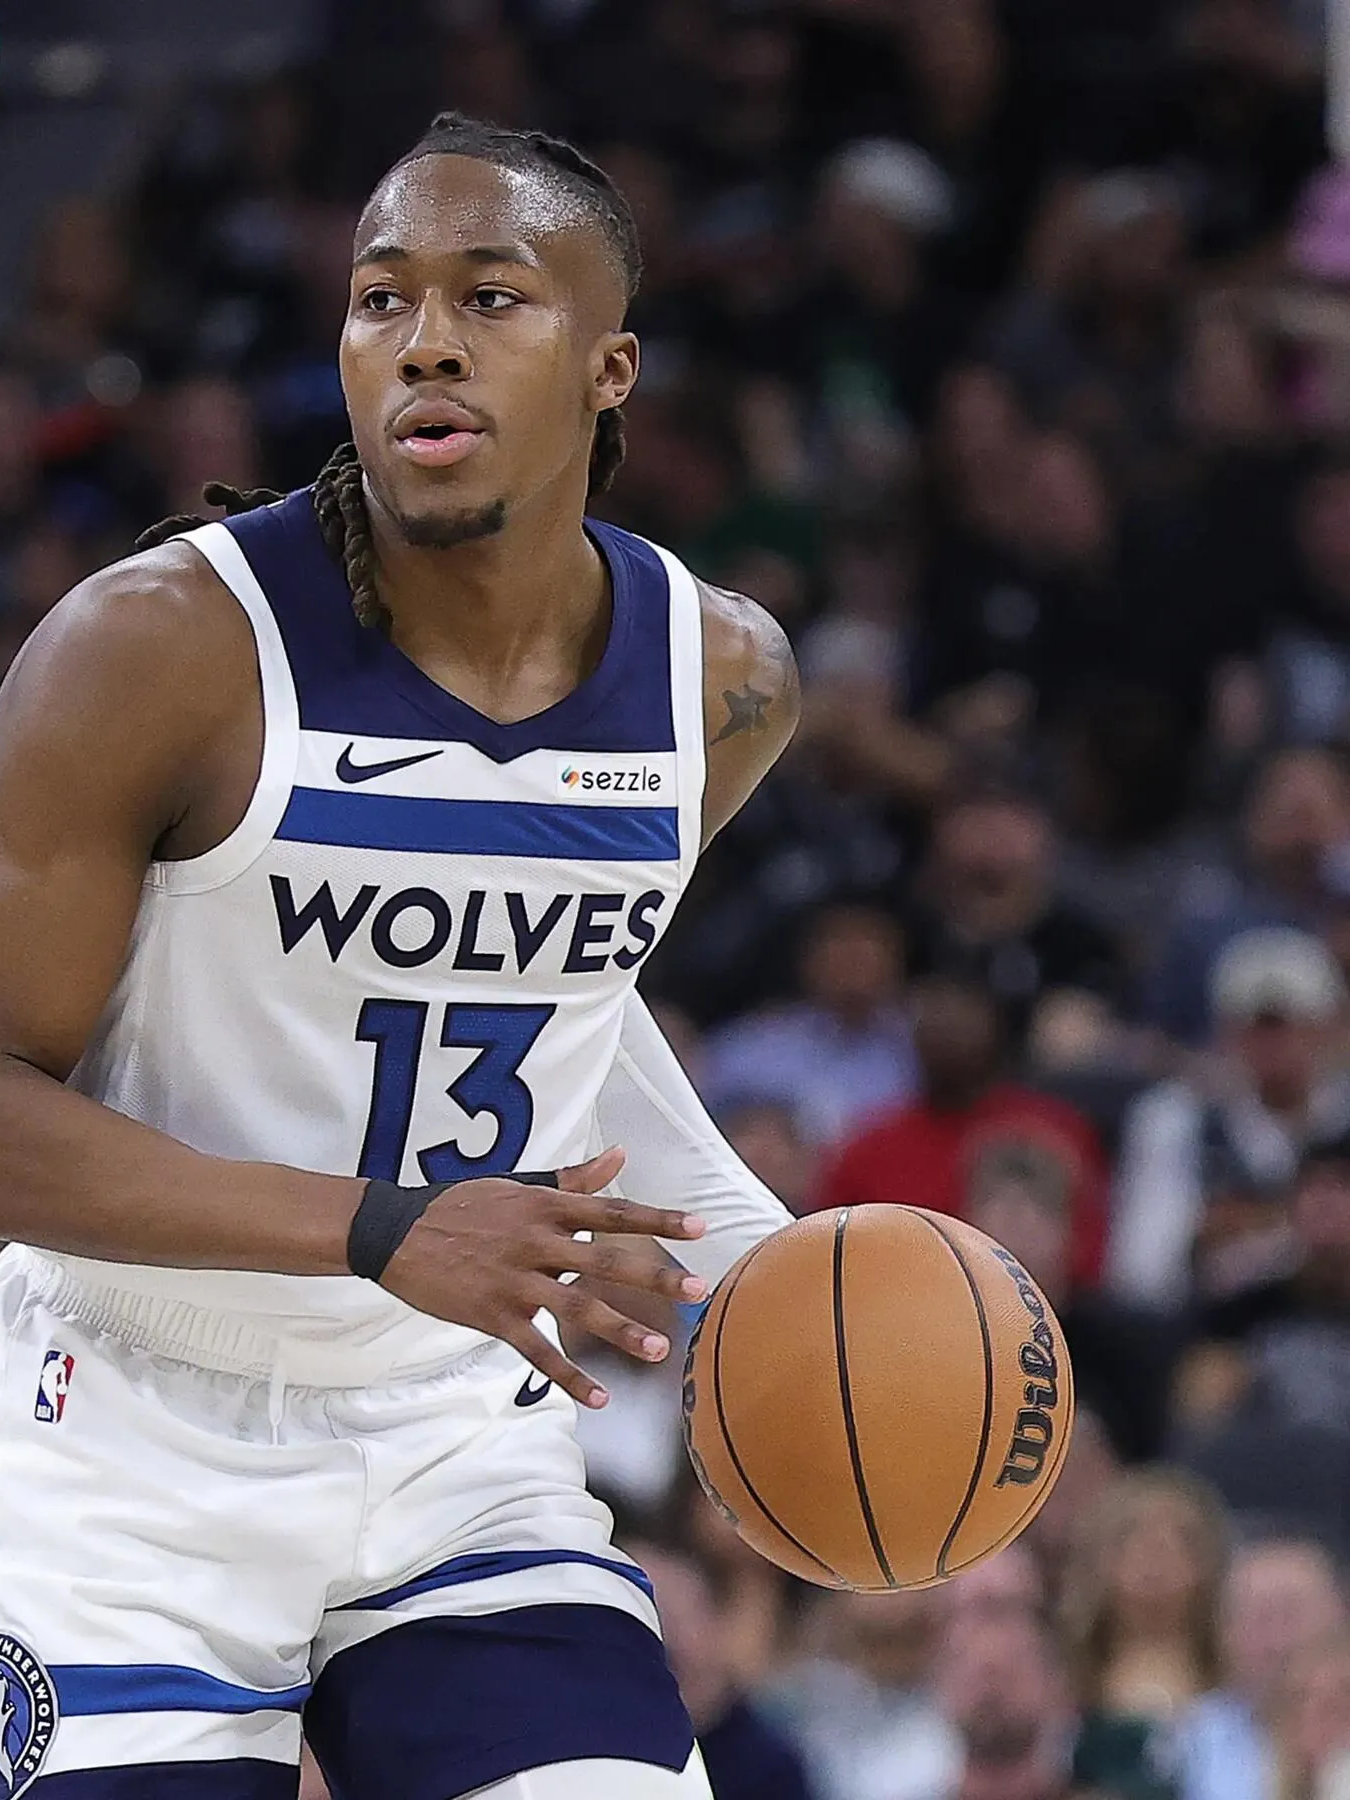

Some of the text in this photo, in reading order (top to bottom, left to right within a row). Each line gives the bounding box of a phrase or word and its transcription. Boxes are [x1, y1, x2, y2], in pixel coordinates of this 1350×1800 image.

[582, 765, 661, 791] sezzle
[269, 874, 666, 975] WOLVES
[354, 997, 557, 1185] 13
